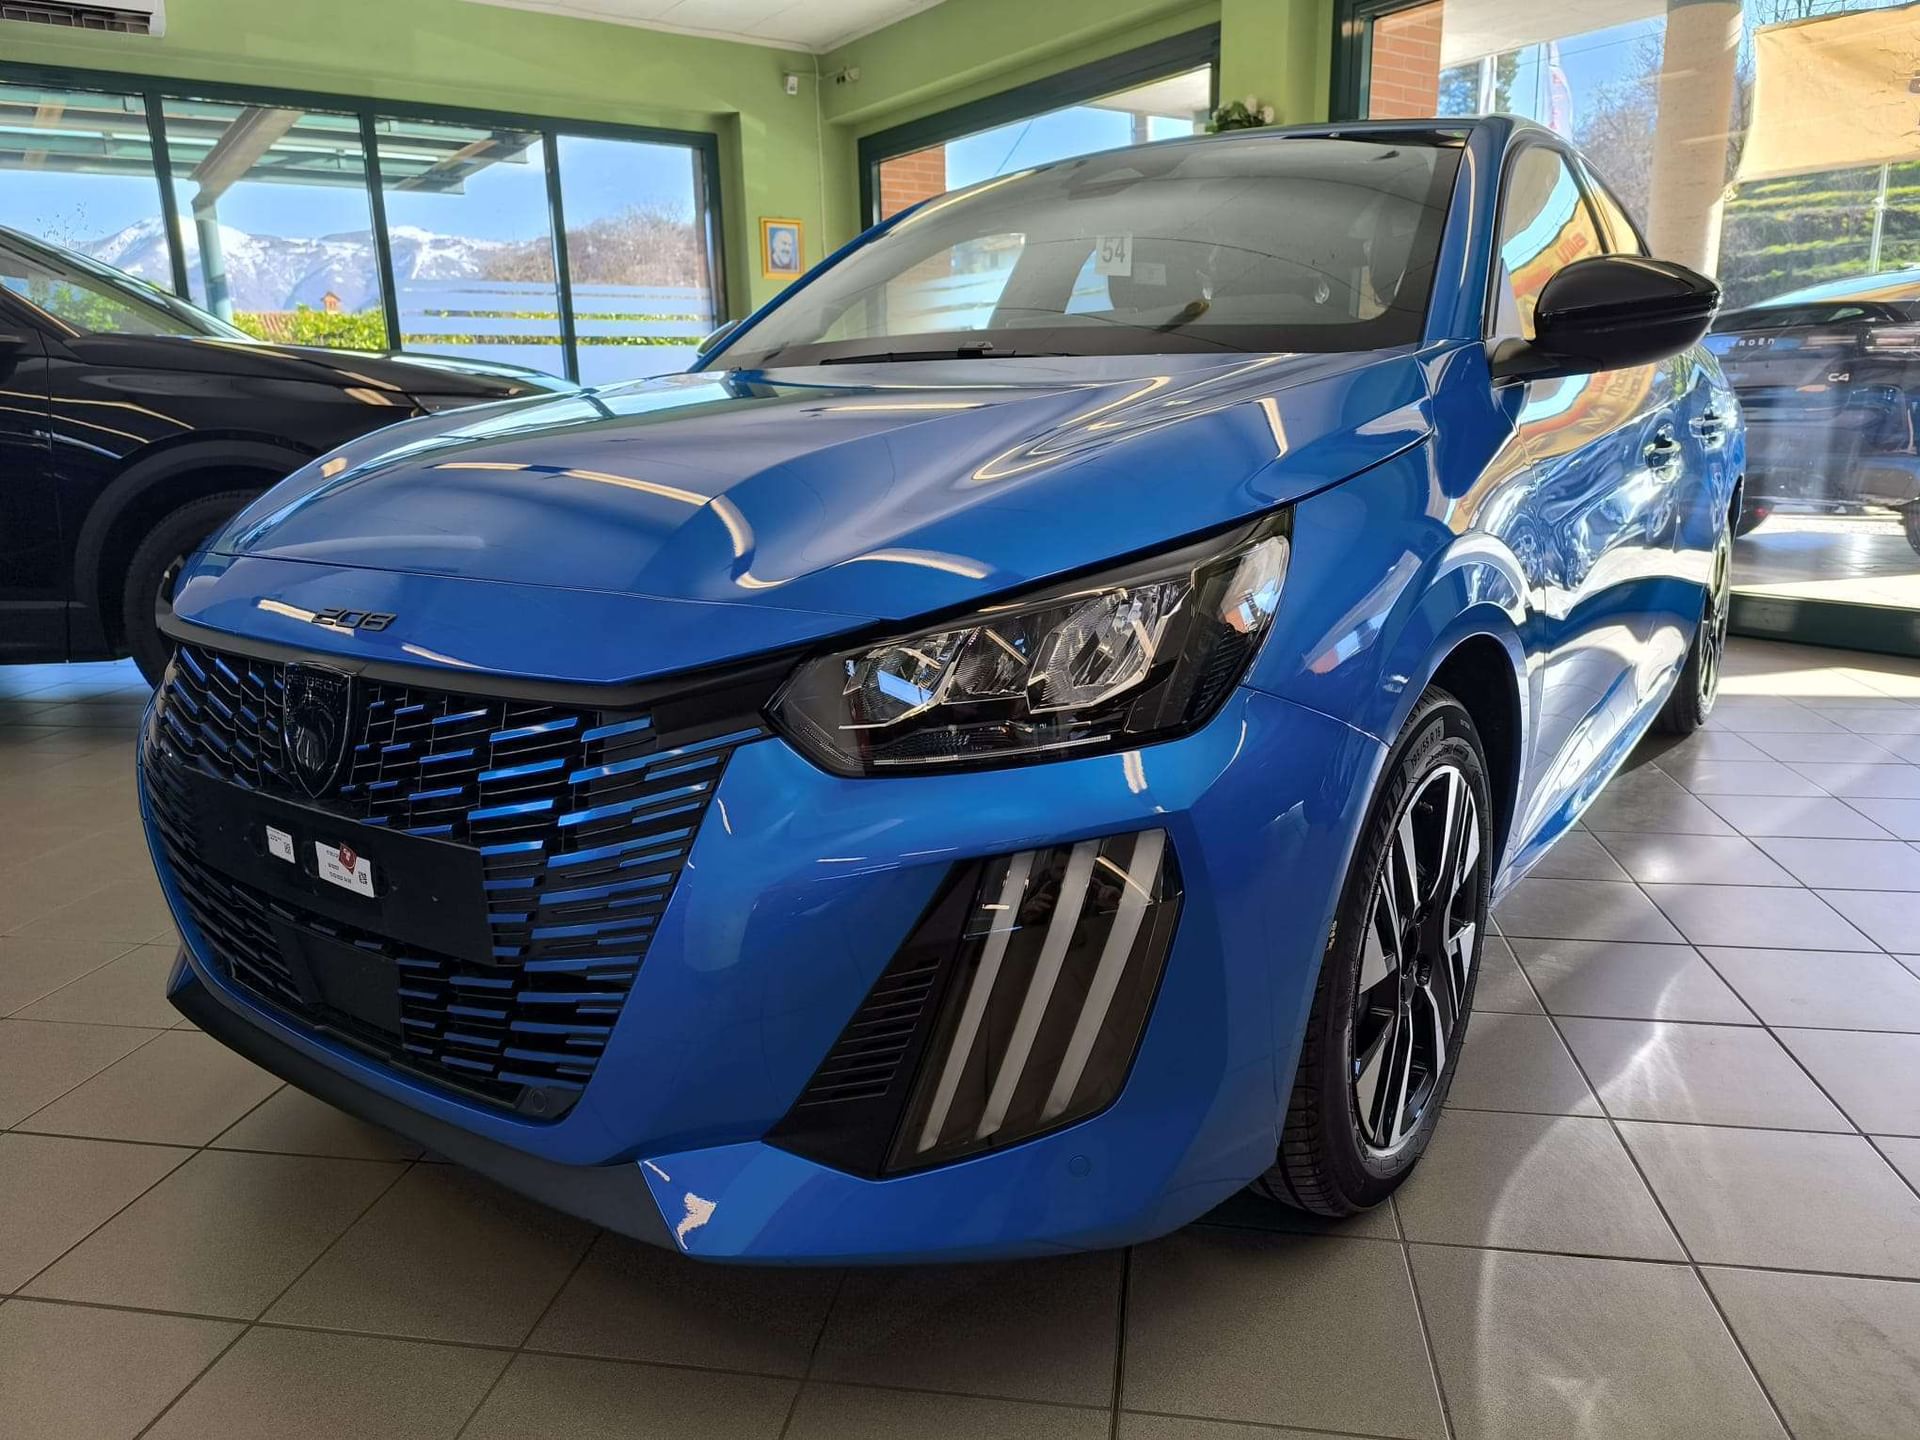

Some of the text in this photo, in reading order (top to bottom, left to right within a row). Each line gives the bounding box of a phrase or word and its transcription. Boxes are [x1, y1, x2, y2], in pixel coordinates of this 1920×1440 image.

[1102, 236, 1126, 263] 54
[1827, 372, 1851, 383] C4
[311, 608, 398, 632] 208
